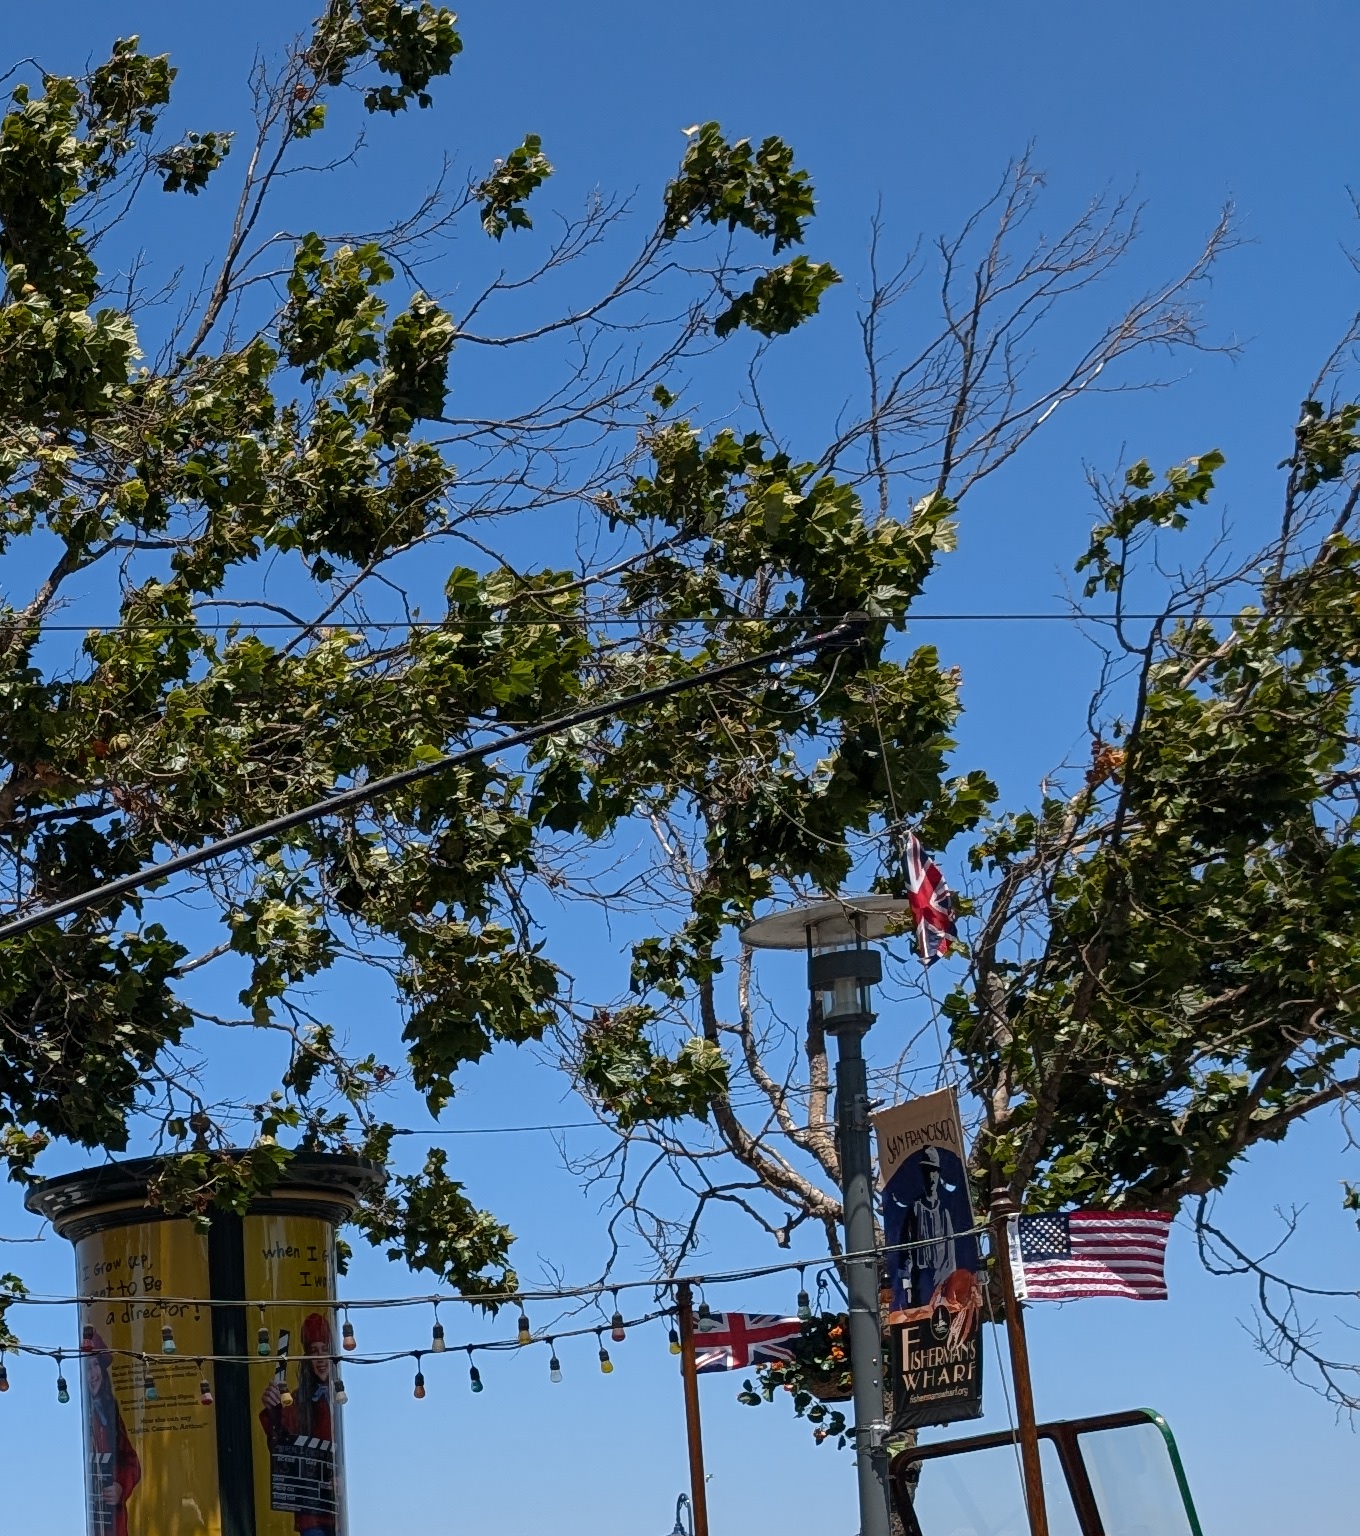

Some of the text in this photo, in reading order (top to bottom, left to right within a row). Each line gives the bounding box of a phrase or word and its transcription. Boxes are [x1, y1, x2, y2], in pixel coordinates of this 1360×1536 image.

[886, 1118, 957, 1164] SAN FRANCISCO
[902, 1326, 976, 1371] FISHERMAN'S
[902, 1361, 976, 1391] WHARF
